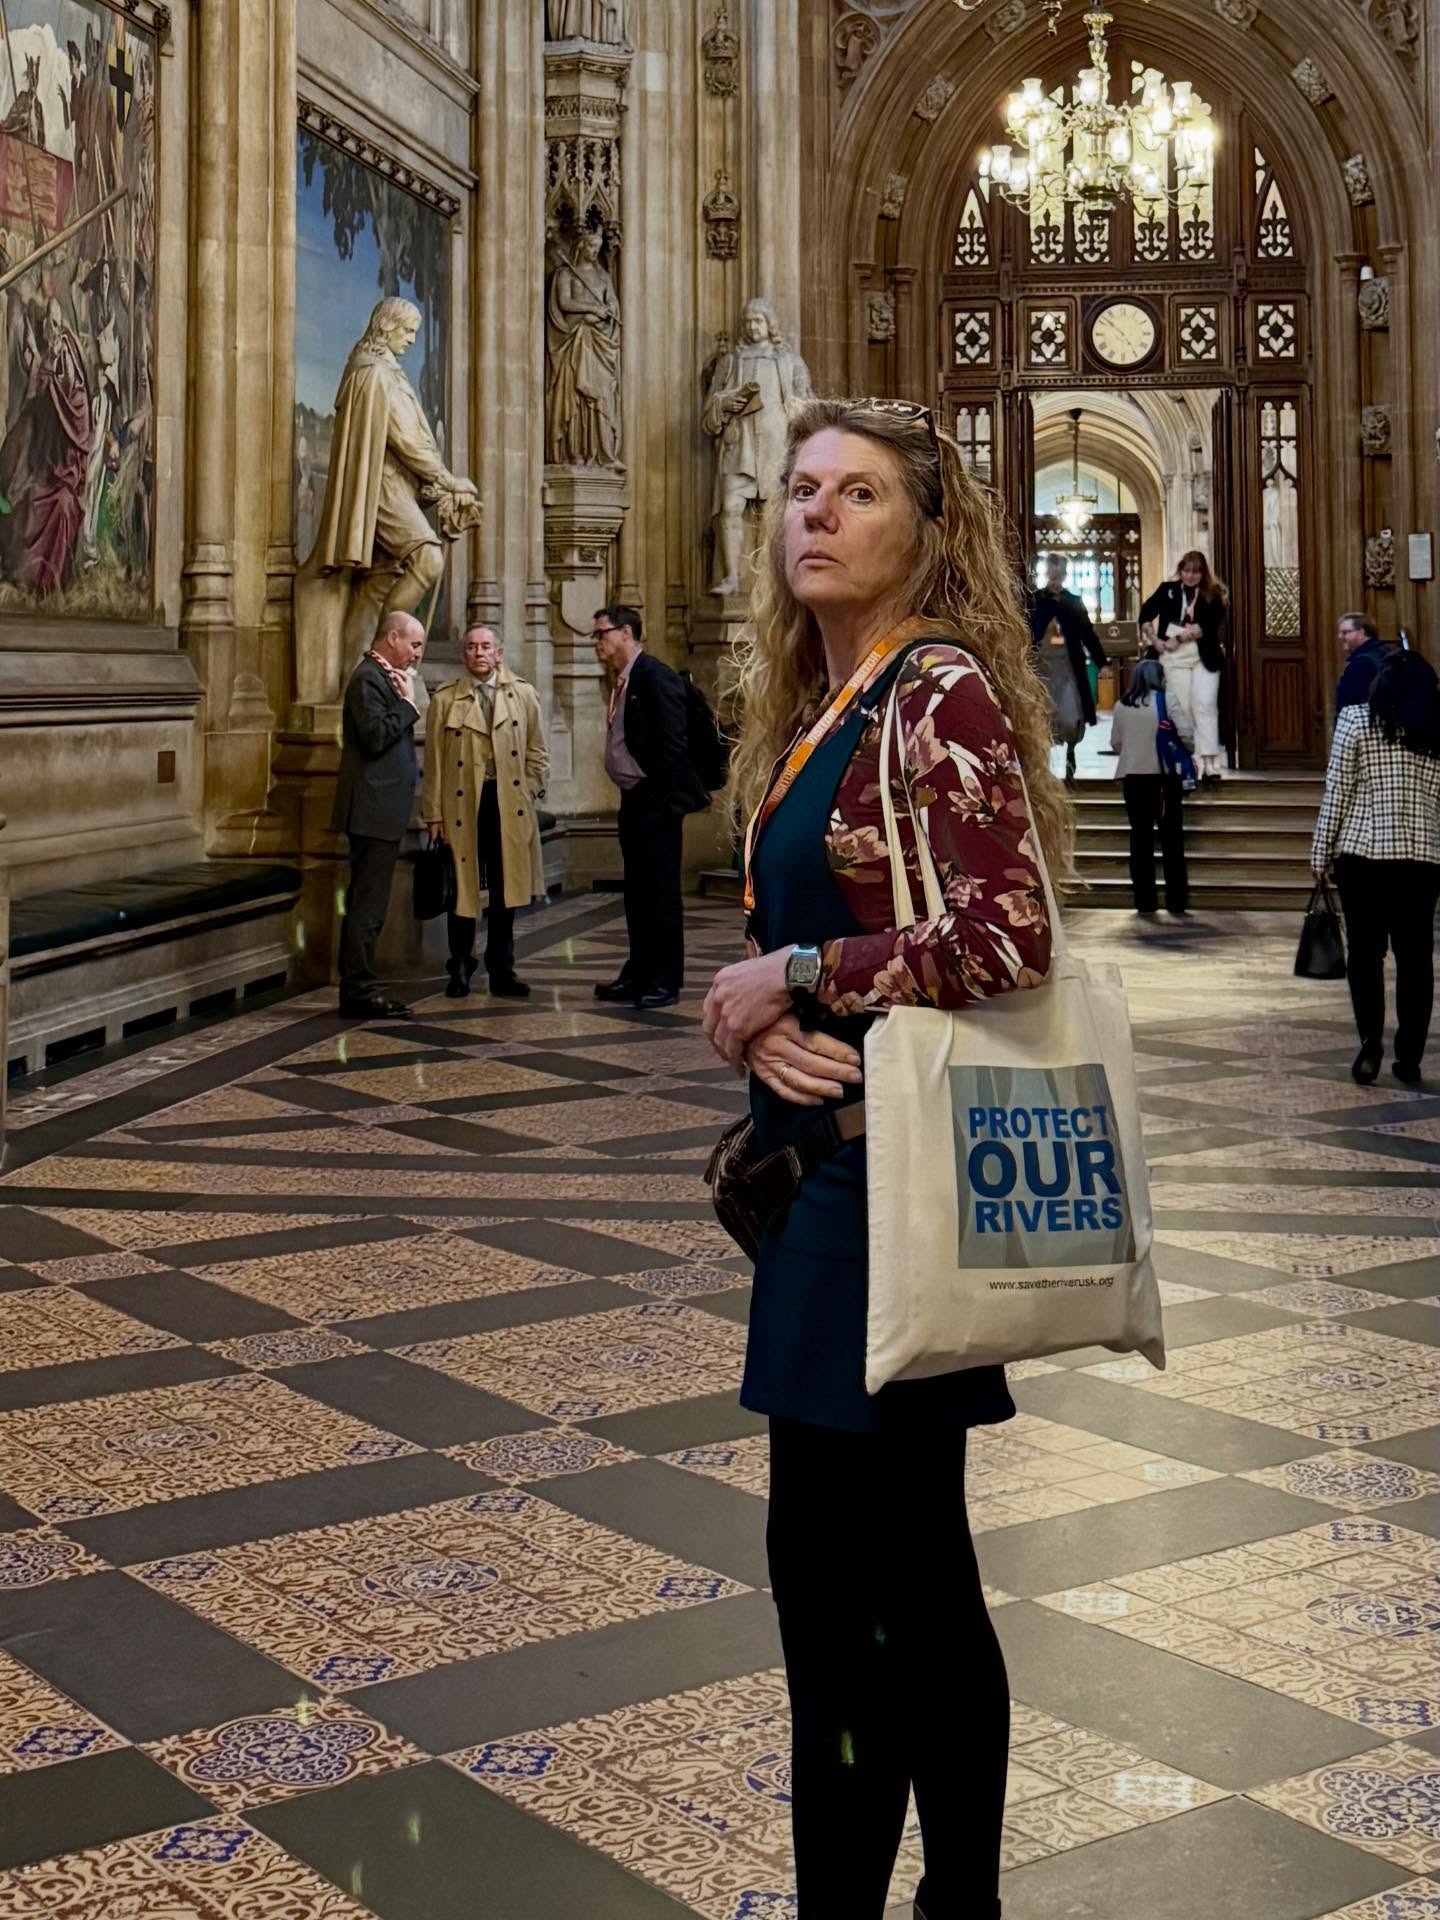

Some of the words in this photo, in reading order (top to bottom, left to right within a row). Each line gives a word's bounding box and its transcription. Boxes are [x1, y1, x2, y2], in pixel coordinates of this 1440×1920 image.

[849, 651, 881, 688] VISITOR
[770, 766, 798, 803] VISITOR
[968, 1105, 1107, 1138] PROTECT
[968, 1140, 1121, 1198] OUR
[975, 1197, 1123, 1233] RIVERS
